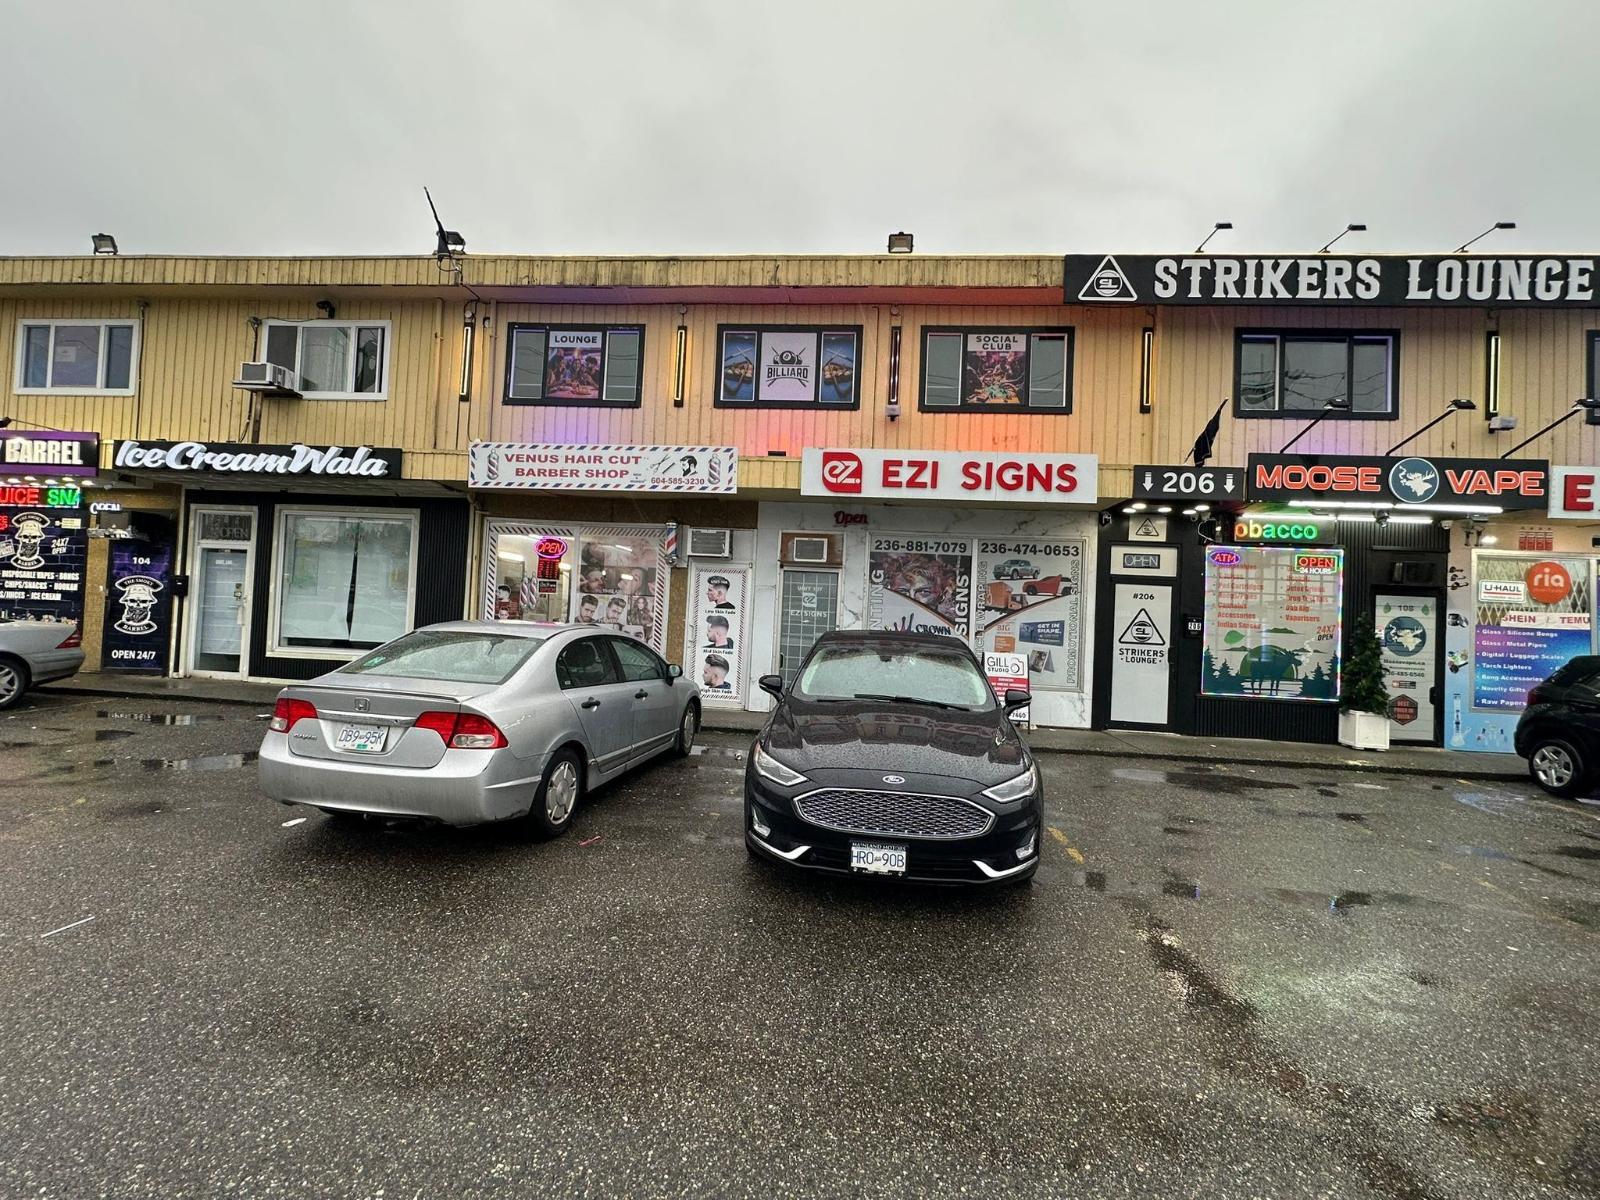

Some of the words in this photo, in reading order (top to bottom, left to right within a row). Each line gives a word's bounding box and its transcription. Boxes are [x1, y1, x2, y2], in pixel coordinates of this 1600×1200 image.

[1154, 259, 1381, 299] STRIKERS
[1405, 259, 1594, 300] LOUNGE
[554, 336, 598, 344] LOUNGE
[766, 366, 808, 379] BILLIARD
[5, 438, 83, 464] BARREL
[504, 454, 559, 463] VENUS
[564, 455, 603, 464] HAIR
[607, 456, 642, 465] CUT
[515, 468, 579, 477] BARBER
[585, 469, 629, 479] SHOP
[882, 460, 939, 488] EZI
[961, 462, 1077, 492] SIGNS
[651, 477, 705, 485] 604-585-3230
[1162, 472, 1215, 493] 206
[1256, 465, 1381, 491] MOOSE
[1445, 469, 1545, 496] VAPE
[1235, 520, 1318, 539] obacco
[539, 542, 564, 553] OPEN
[875, 540, 967, 553] 236-881-7079
[981, 543, 1079, 556] 236-474-0653
[132, 557, 150, 565] 104
[1125, 554, 1159, 567] OPEN
[1214, 553, 1237, 563] ATM
[1299, 557, 1333, 567] OPEN
[1071, 560, 1079, 596] SIGNS
[1533, 568, 1565, 587] ria
[1484, 584, 1521, 593] U-HAUL
[1133, 593, 1155, 601] #206
[955, 574, 969, 636] SIGNS
[916, 624, 951, 635] CROWN
[1316, 625, 1336, 634] 24X7
[112, 650, 135, 659] OPEN
[137, 651, 156, 661] 24/7
[1119, 648, 1165, 658] STRIKERS
[987, 656, 1009, 668] GILL
[364, 731, 384, 745] 95K
